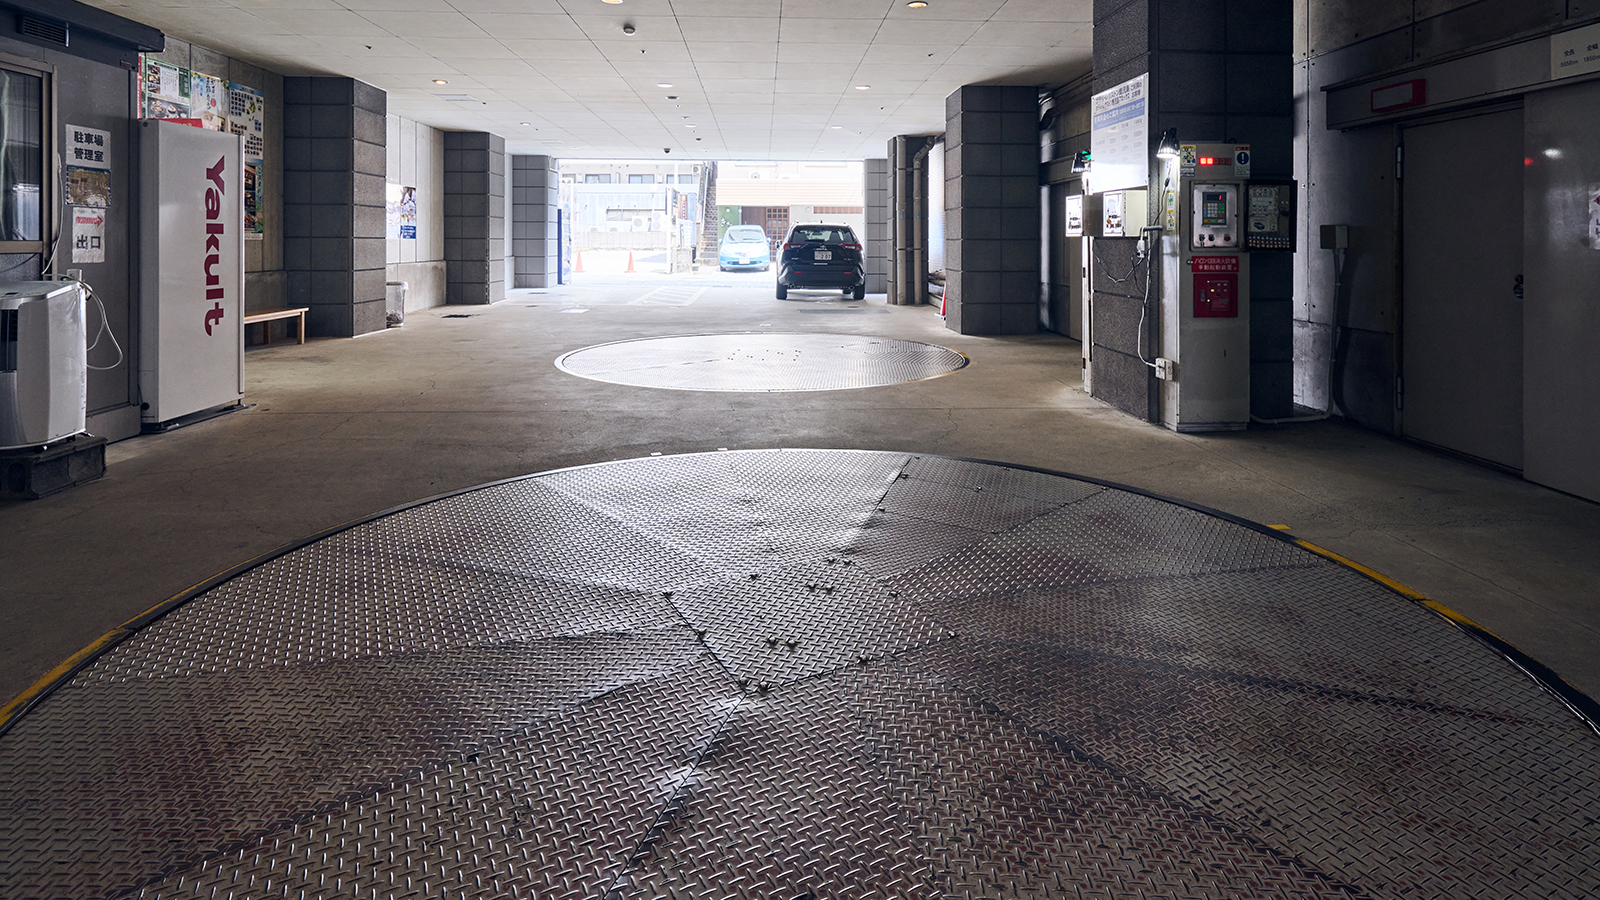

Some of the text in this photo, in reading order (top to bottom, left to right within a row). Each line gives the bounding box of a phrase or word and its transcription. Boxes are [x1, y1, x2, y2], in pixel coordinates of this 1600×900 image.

[74, 131, 104, 147] 駐車場
[74, 147, 104, 162] 管理室
[76, 235, 102, 250] 出口
[204, 154, 225, 337] Yakult
